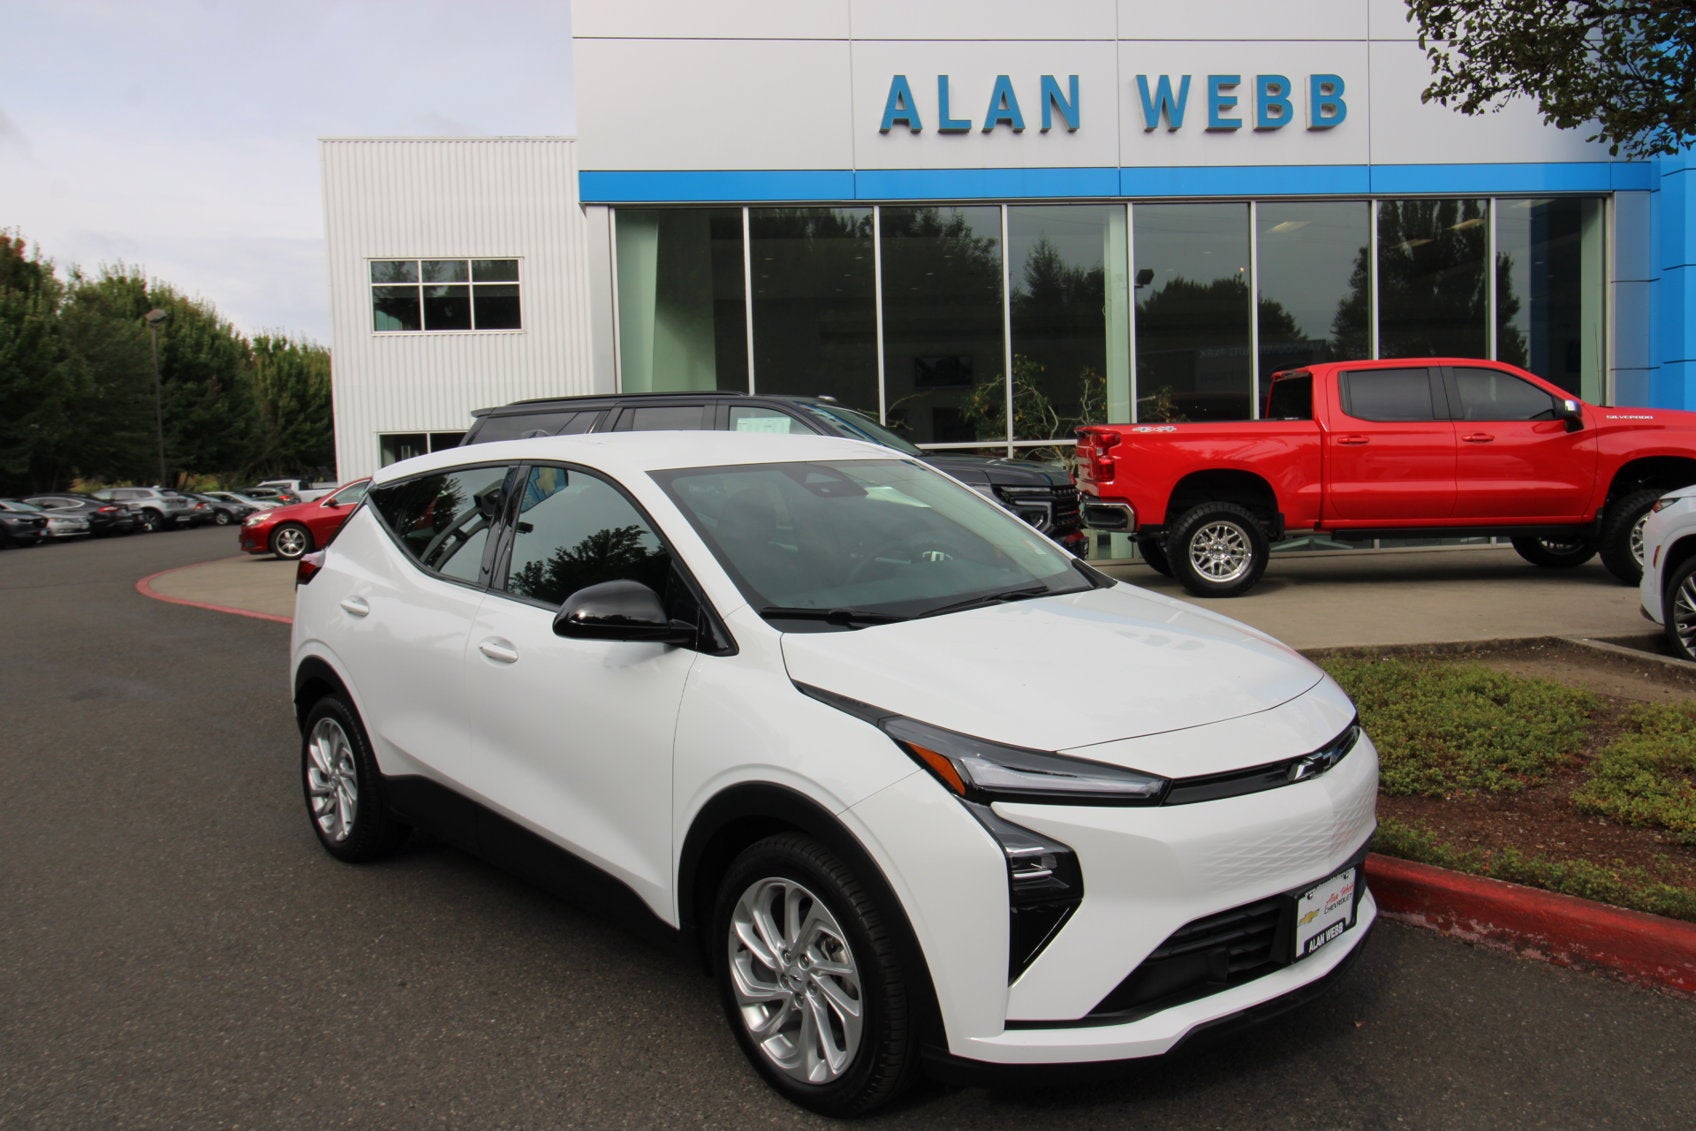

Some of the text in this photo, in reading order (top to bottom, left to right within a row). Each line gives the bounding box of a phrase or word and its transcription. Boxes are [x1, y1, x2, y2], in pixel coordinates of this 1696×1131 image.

[879, 74, 1348, 134] ALAN WEBB
[1309, 921, 1344, 952] ALAN WEBB
